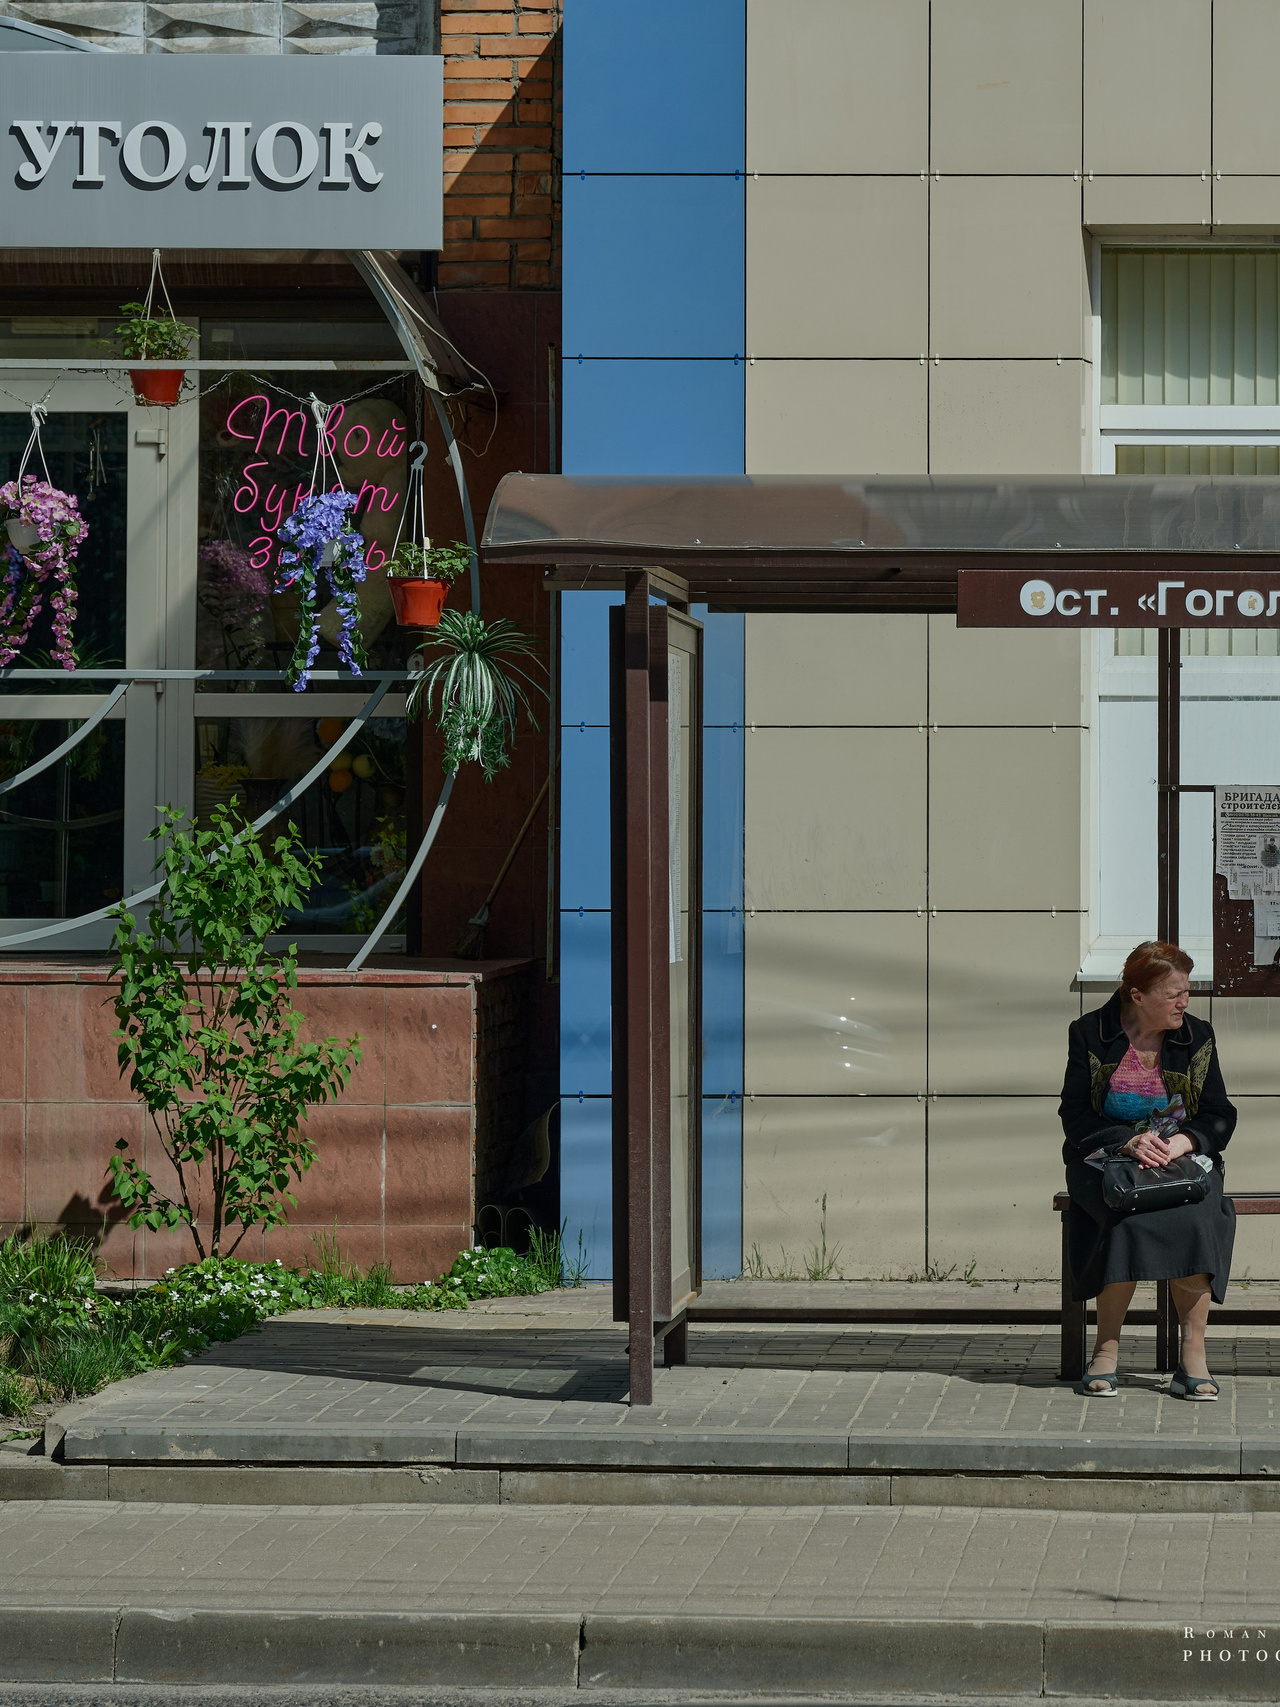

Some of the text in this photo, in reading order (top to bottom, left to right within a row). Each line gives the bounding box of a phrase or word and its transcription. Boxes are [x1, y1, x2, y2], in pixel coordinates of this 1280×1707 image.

[10, 119, 385, 187] УГОЛОК
[1019, 579, 1119, 617] Ост.
[1224, 792, 1280, 803] БРИГАДА
